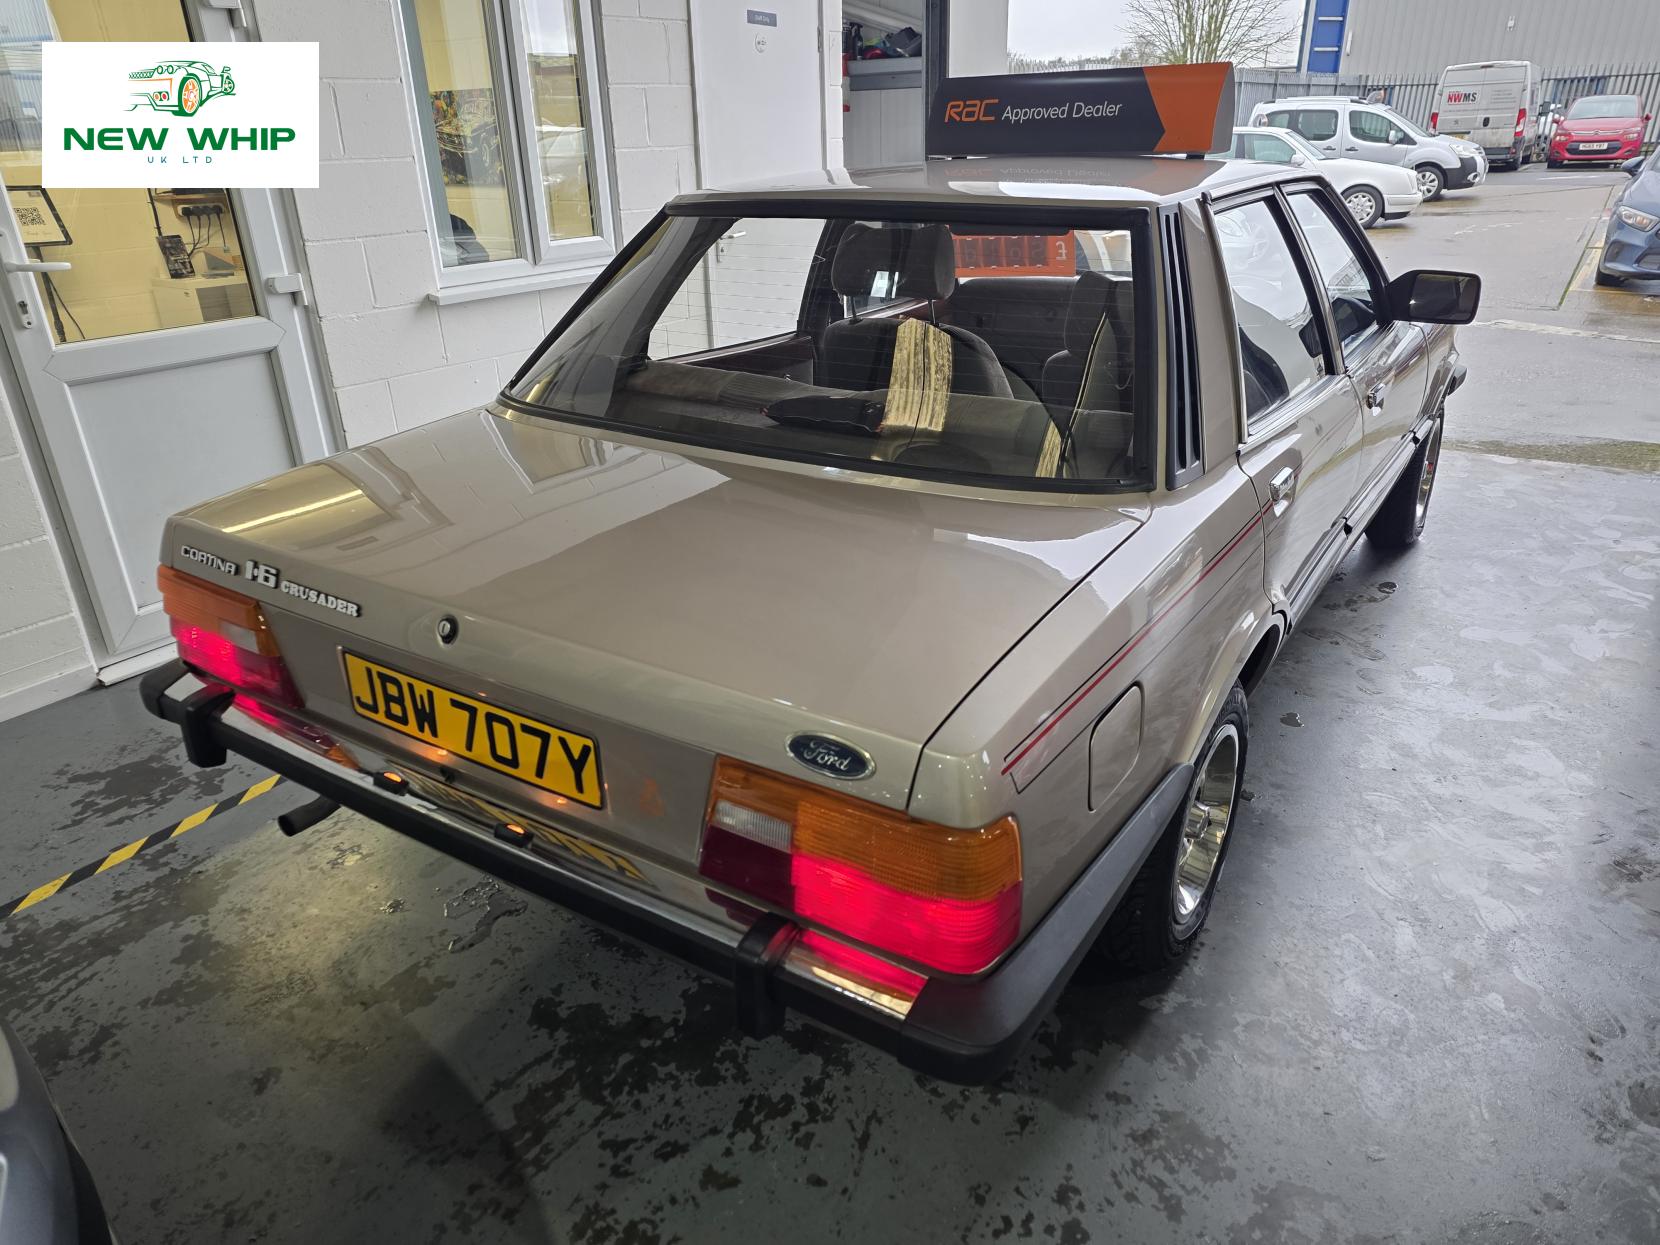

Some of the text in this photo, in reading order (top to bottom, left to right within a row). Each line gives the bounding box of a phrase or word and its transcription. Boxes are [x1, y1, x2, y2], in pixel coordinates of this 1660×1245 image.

[1001, 102, 1070, 124] Approved
[1072, 101, 1122, 118] Dealer
[1447, 92, 1477, 103] NWMS
[181, 545, 238, 576] CORTINA
[280, 580, 360, 617] CRUSADER
[355, 666, 592, 794] JBW 707Y
[803, 740, 852, 770] Ford
